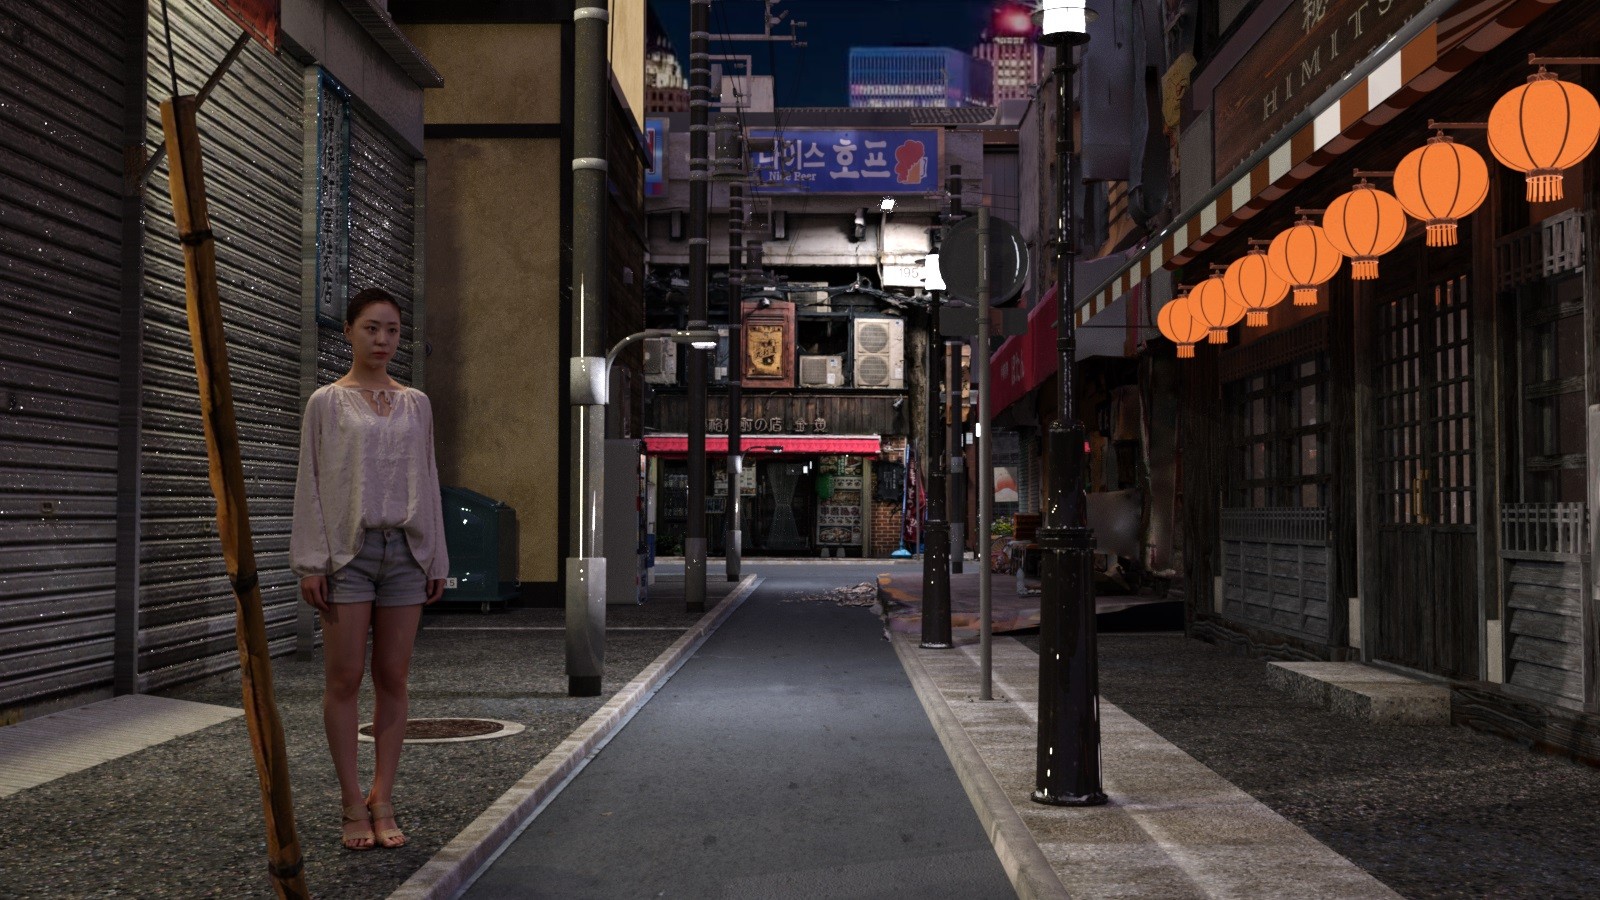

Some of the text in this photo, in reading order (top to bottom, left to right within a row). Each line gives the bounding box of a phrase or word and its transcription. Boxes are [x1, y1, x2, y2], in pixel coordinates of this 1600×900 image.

[758, 138, 891, 180] 나이스 호프
[899, 267, 919, 279] 195
